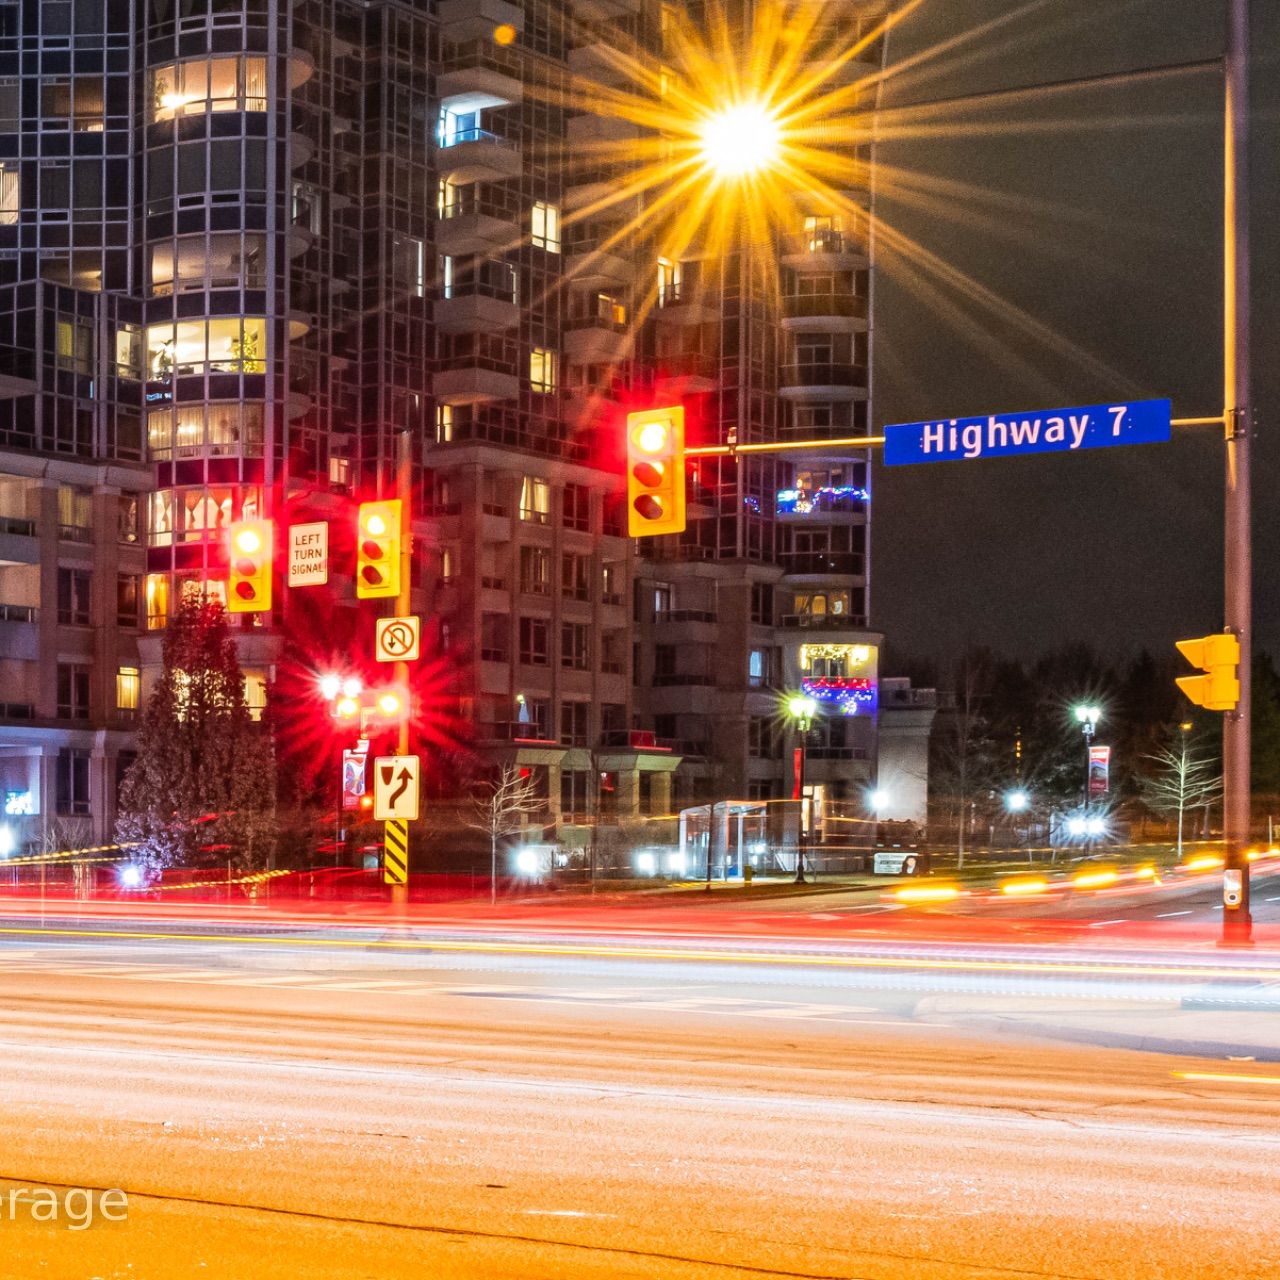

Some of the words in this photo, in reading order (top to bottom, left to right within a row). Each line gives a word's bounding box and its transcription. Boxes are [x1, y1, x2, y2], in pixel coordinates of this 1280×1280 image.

[922, 414, 1090, 458] Highway
[1107, 405, 1128, 437] 7
[295, 534, 320, 545] LEFT
[294, 548, 322, 560] TURN
[292, 563, 323, 575] SIGNAL
